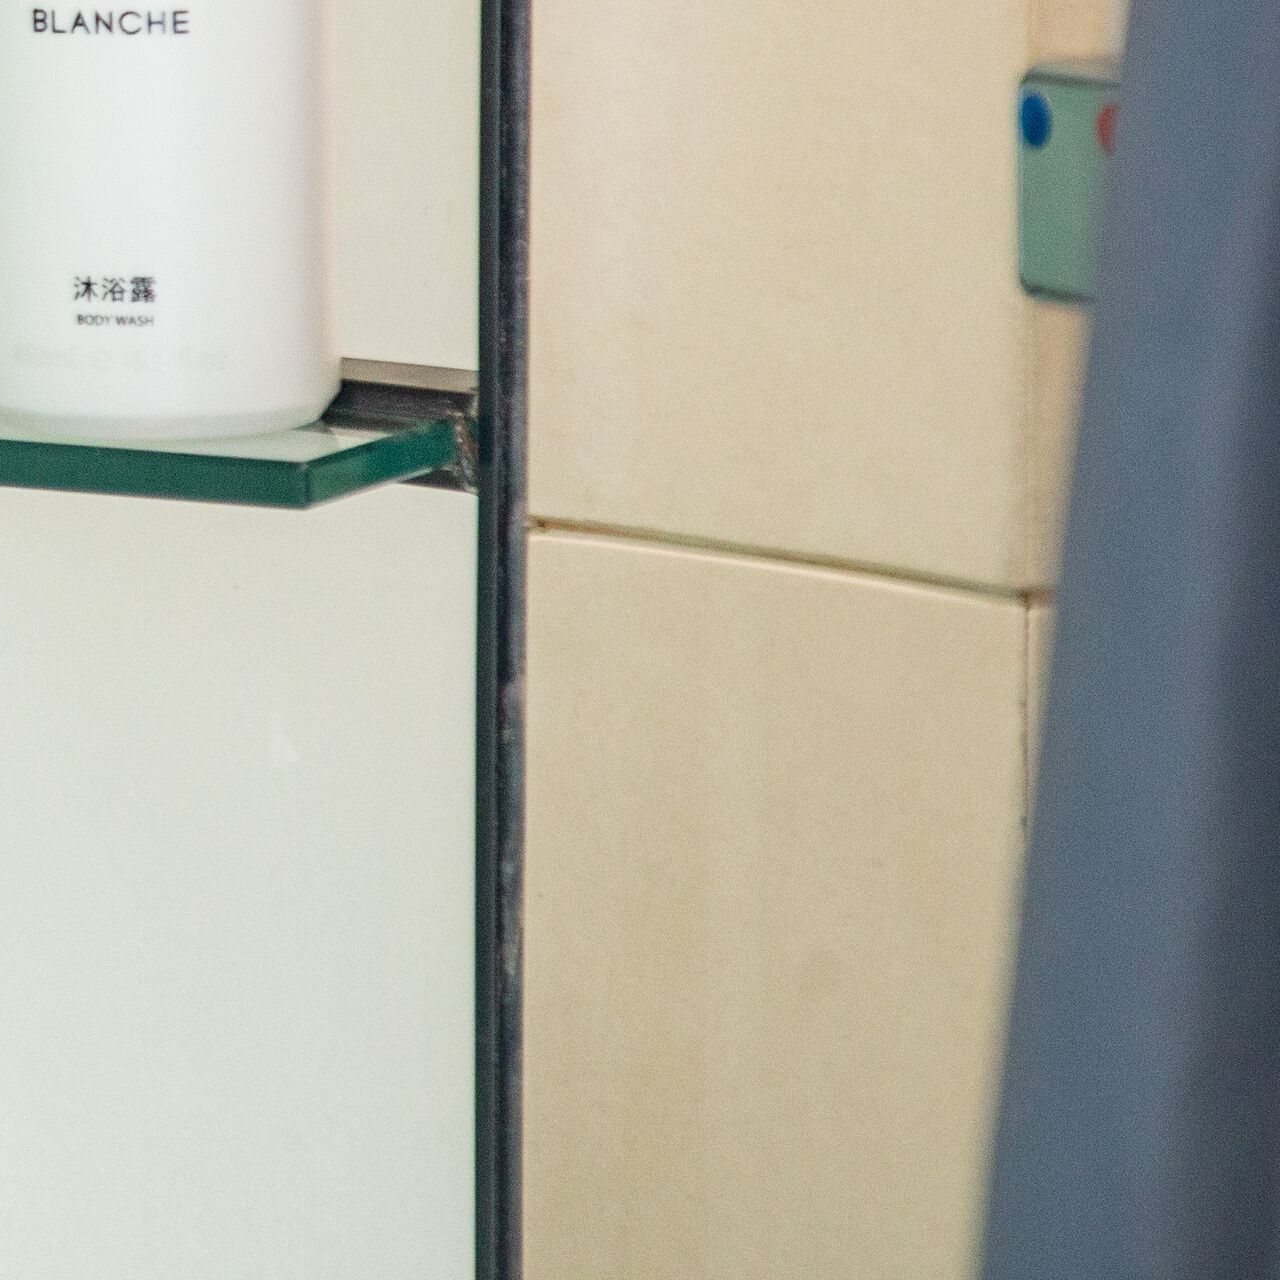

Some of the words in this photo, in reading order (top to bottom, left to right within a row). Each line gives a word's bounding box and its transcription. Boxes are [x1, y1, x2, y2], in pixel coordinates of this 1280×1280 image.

[31, 7, 189, 36] BLANCHE
[74, 276, 156, 304] 沐浴露
[75, 313, 111, 327] BODY
[114, 315, 154, 327] WASH
